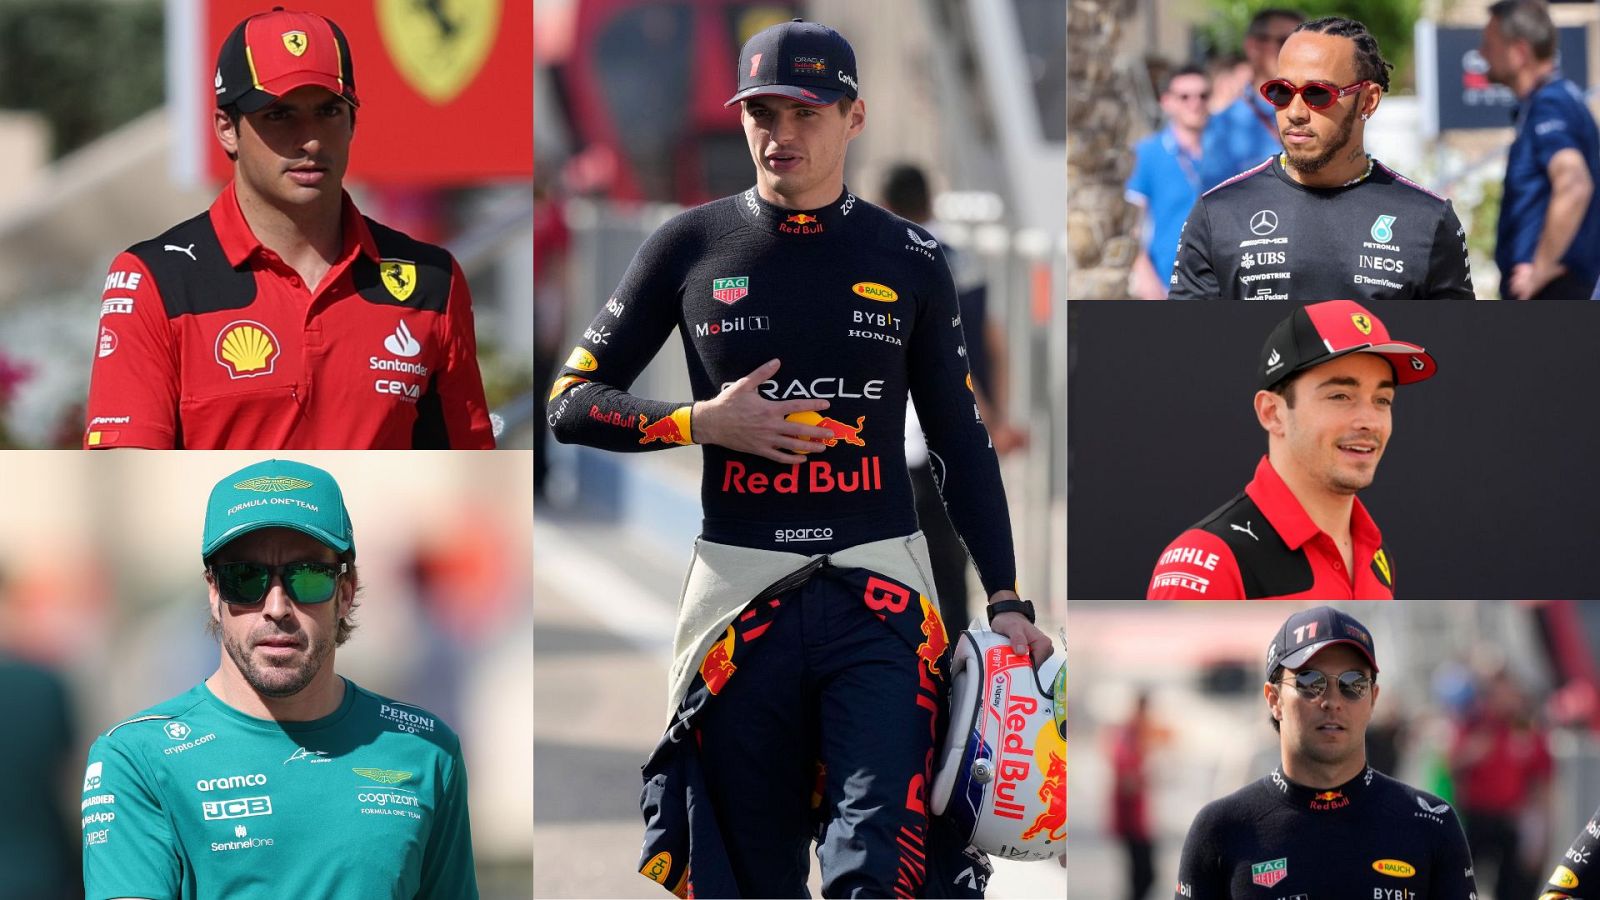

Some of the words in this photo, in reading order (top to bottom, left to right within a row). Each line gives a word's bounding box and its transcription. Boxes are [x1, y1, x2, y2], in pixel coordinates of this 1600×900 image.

[750, 53, 762, 78] 1
[779, 223, 801, 234] Red
[802, 223, 824, 234] Bull
[1363, 241, 1400, 252] PETRONAS
[1256, 251, 1286, 265] UBS
[1359, 254, 1404, 273] INEOS
[716, 278, 745, 288] TAG
[1243, 271, 1291, 282] CROWDSTRIKE
[1362, 276, 1404, 290] TeamViewer
[714, 288, 746, 302] HEUER
[865, 286, 893, 299] RAUCH
[696, 317, 745, 338] Mobil
[853, 310, 901, 331] BYBIT
[848, 329, 902, 346] HONDA
[369, 356, 428, 376] Santander
[548, 398, 569, 427] Cash
[589, 404, 612, 424] Red
[612, 410, 635, 429] Bull
[721, 460, 800, 494] Red
[809, 455, 882, 494] Bull
[227, 498, 268, 516] FORMULA
[295, 500, 319, 513] TEAM
[775, 527, 833, 543] sparco
[1160, 547, 1220, 572] MAHLE
[1293, 621, 1318, 644] 11
[380, 703, 435, 729] PERONI
[1003, 694, 1038, 756] Red
[164, 733, 216, 755] crypto.com
[196, 773, 267, 792] aramco
[993, 758, 1030, 821] Bull
[204, 798, 270, 818] JCB
[357, 791, 419, 807] cognizant
[1310, 800, 1330, 811] Red
[1331, 797, 1350, 809] Bull
[211, 838, 274, 852] SentinelOne
[1255, 860, 1284, 873] TAG
[1384, 863, 1412, 875] RAUCH
